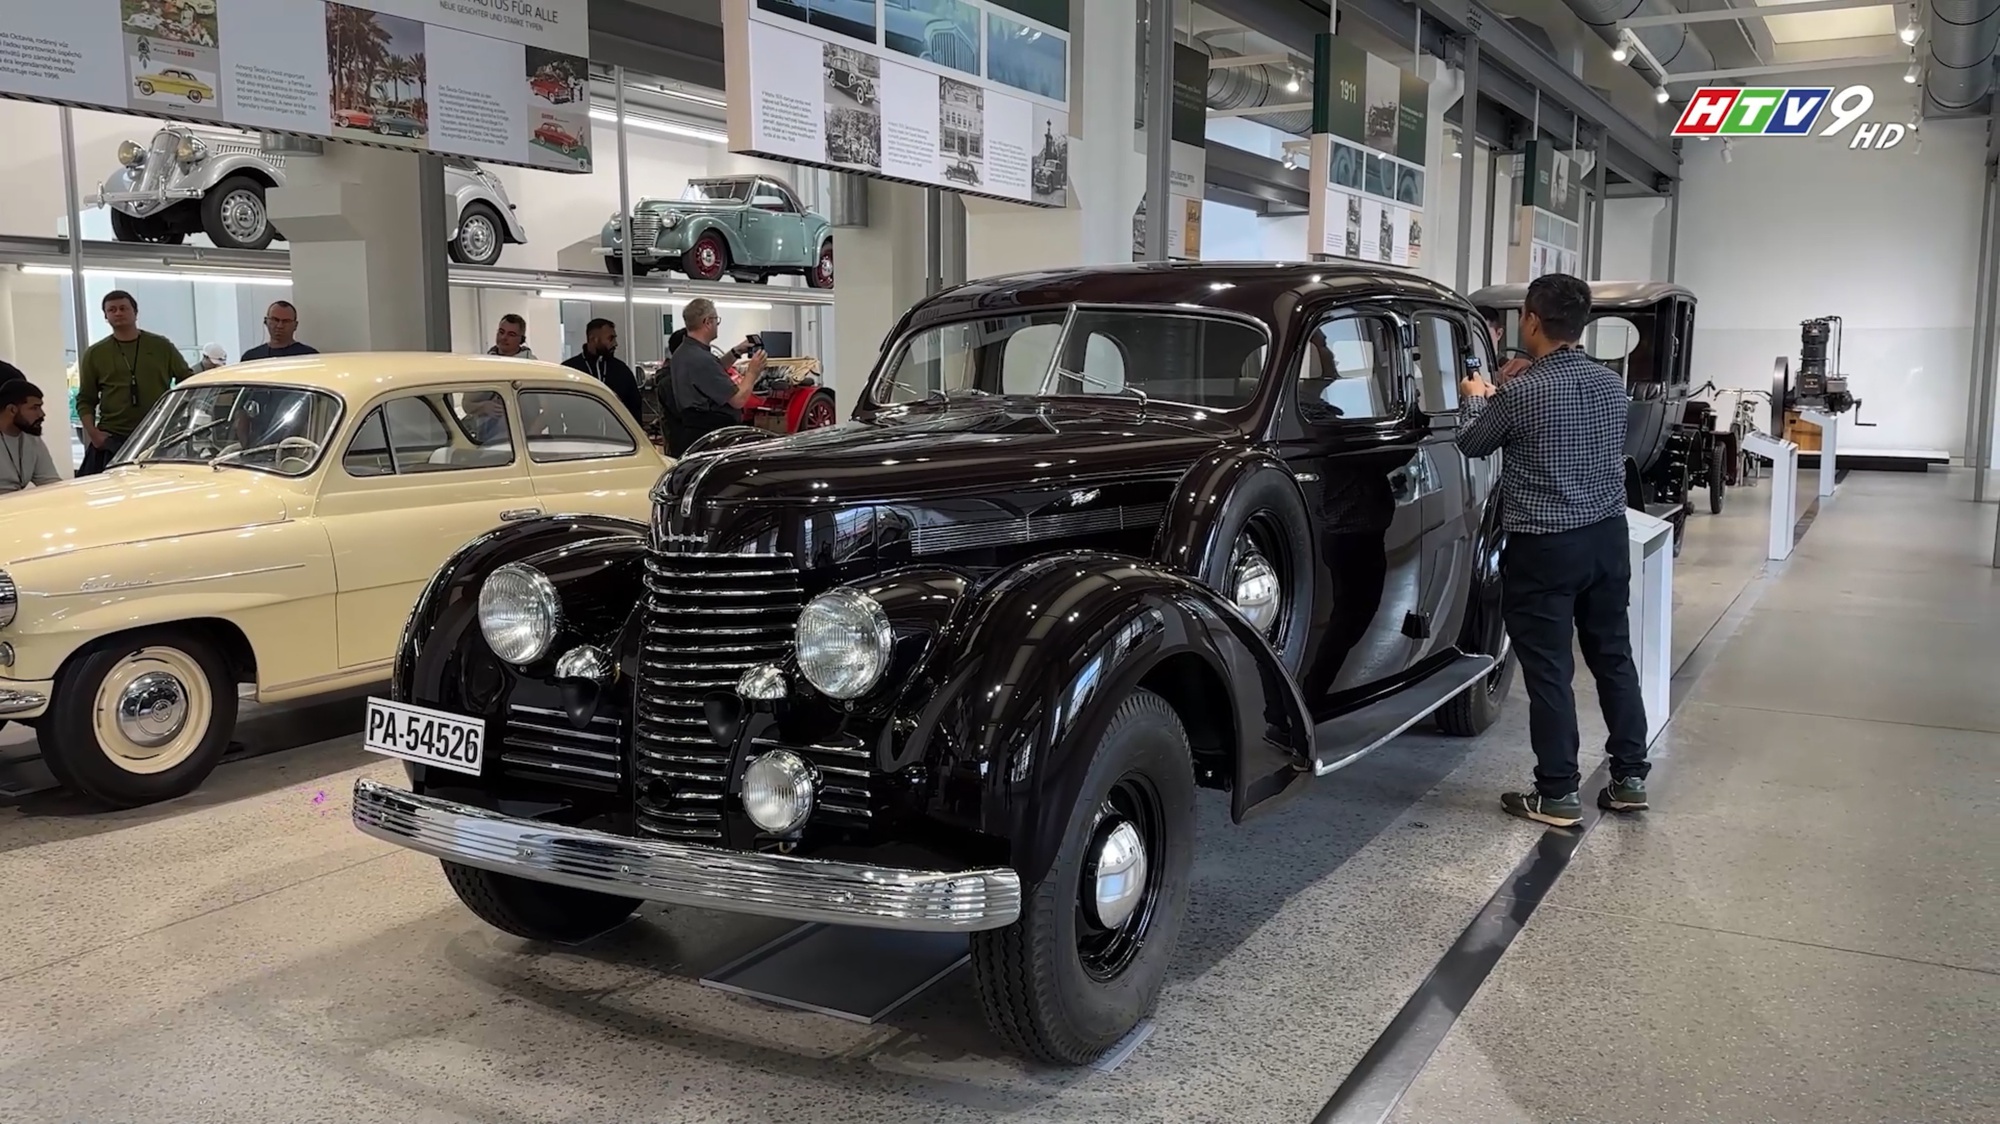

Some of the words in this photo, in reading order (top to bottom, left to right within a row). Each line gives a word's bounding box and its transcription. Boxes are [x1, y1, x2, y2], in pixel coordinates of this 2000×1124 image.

[440, 2, 456, 12] NEUE
[457, 5, 489, 18] GESICHTER
[489, 12, 503, 22] UND
[525, 21, 543, 32] TYPEN
[512, 0, 532, 18] FÜR
[535, 7, 559, 24] ALLE
[1340, 79, 1356, 104] 1911
[369, 708, 479, 763] PA-54526
